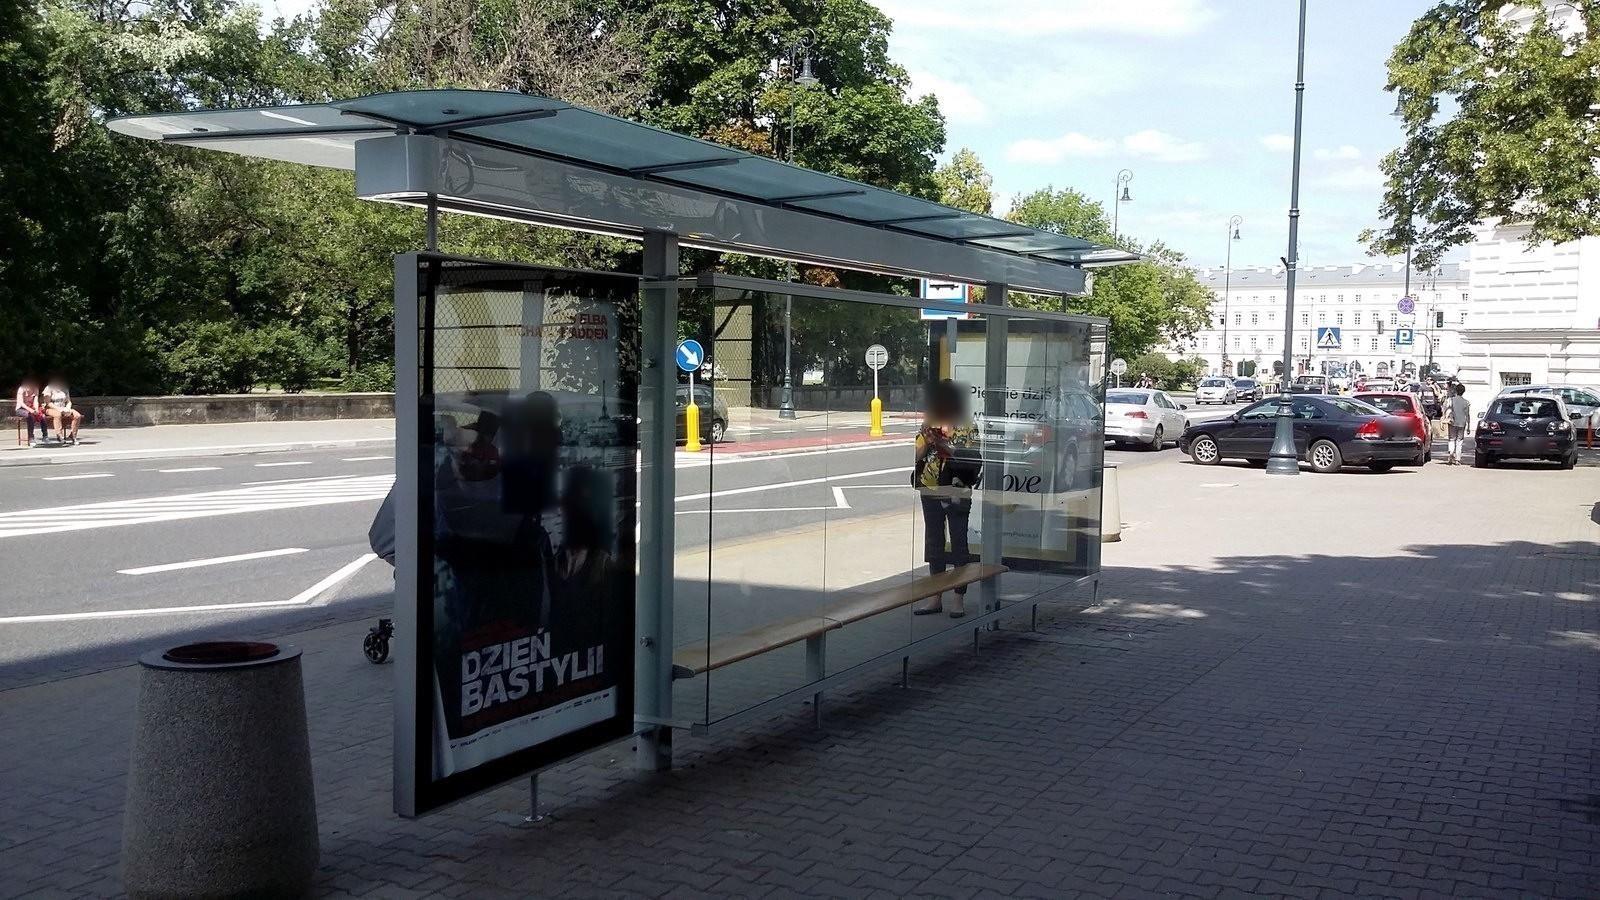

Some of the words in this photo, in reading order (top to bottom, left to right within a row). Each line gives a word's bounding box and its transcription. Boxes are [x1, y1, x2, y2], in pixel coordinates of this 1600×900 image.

[580, 313, 608, 325] ELBA
[1398, 330, 1410, 343] P
[971, 386, 1018, 399] Piie
[976, 471, 1041, 494] ove
[461, 625, 550, 682] DZIEŃ
[461, 644, 604, 717] BASTYLII
